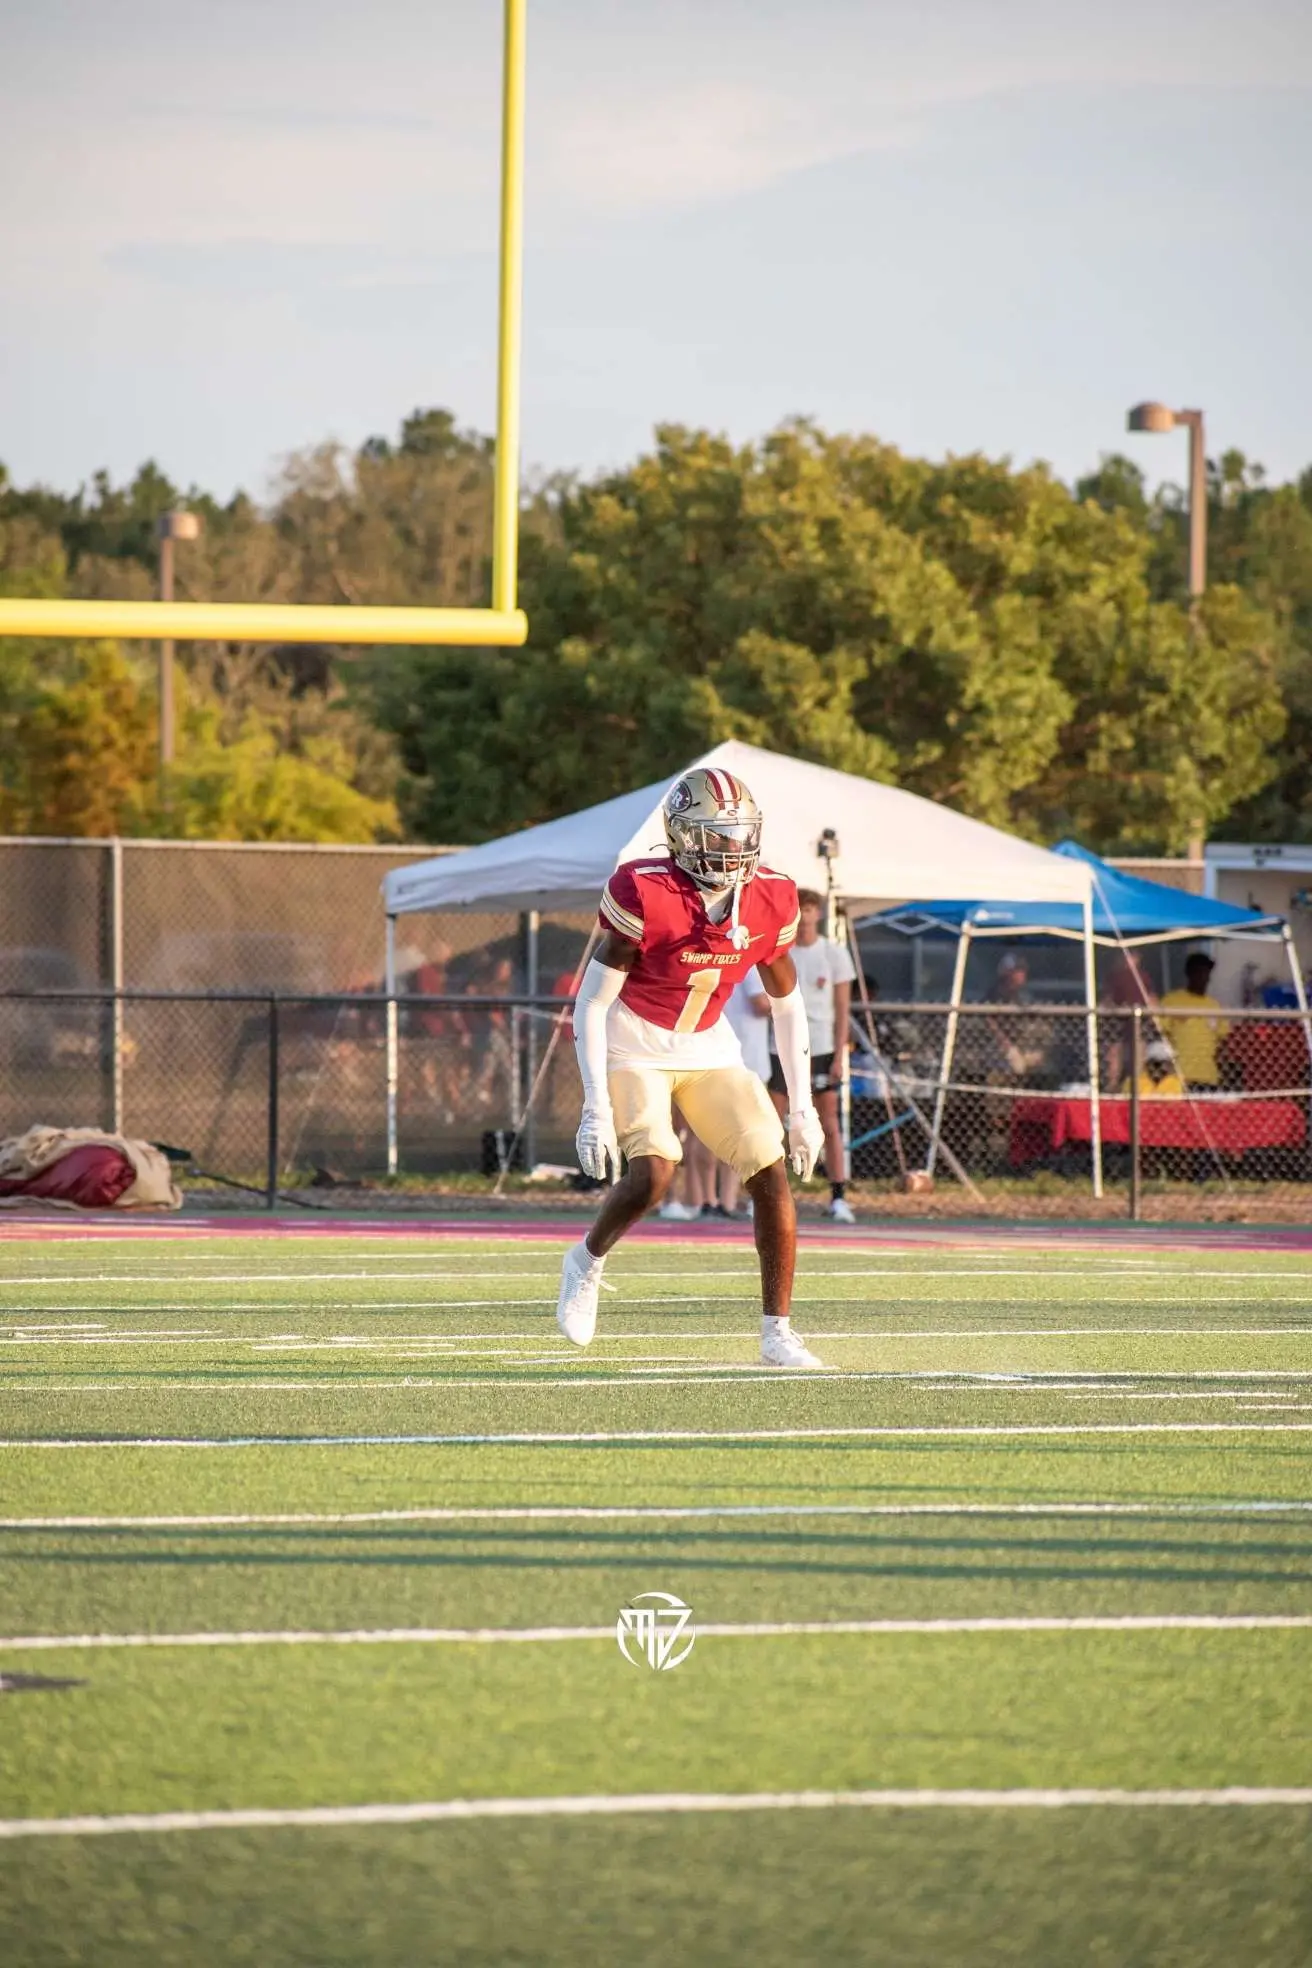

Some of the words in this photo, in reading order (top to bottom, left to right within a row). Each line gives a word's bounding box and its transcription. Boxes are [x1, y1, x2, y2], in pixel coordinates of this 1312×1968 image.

[680, 951, 712, 965] SWAMP
[712, 953, 742, 965] FOXES
[673, 968, 722, 1033] 1
